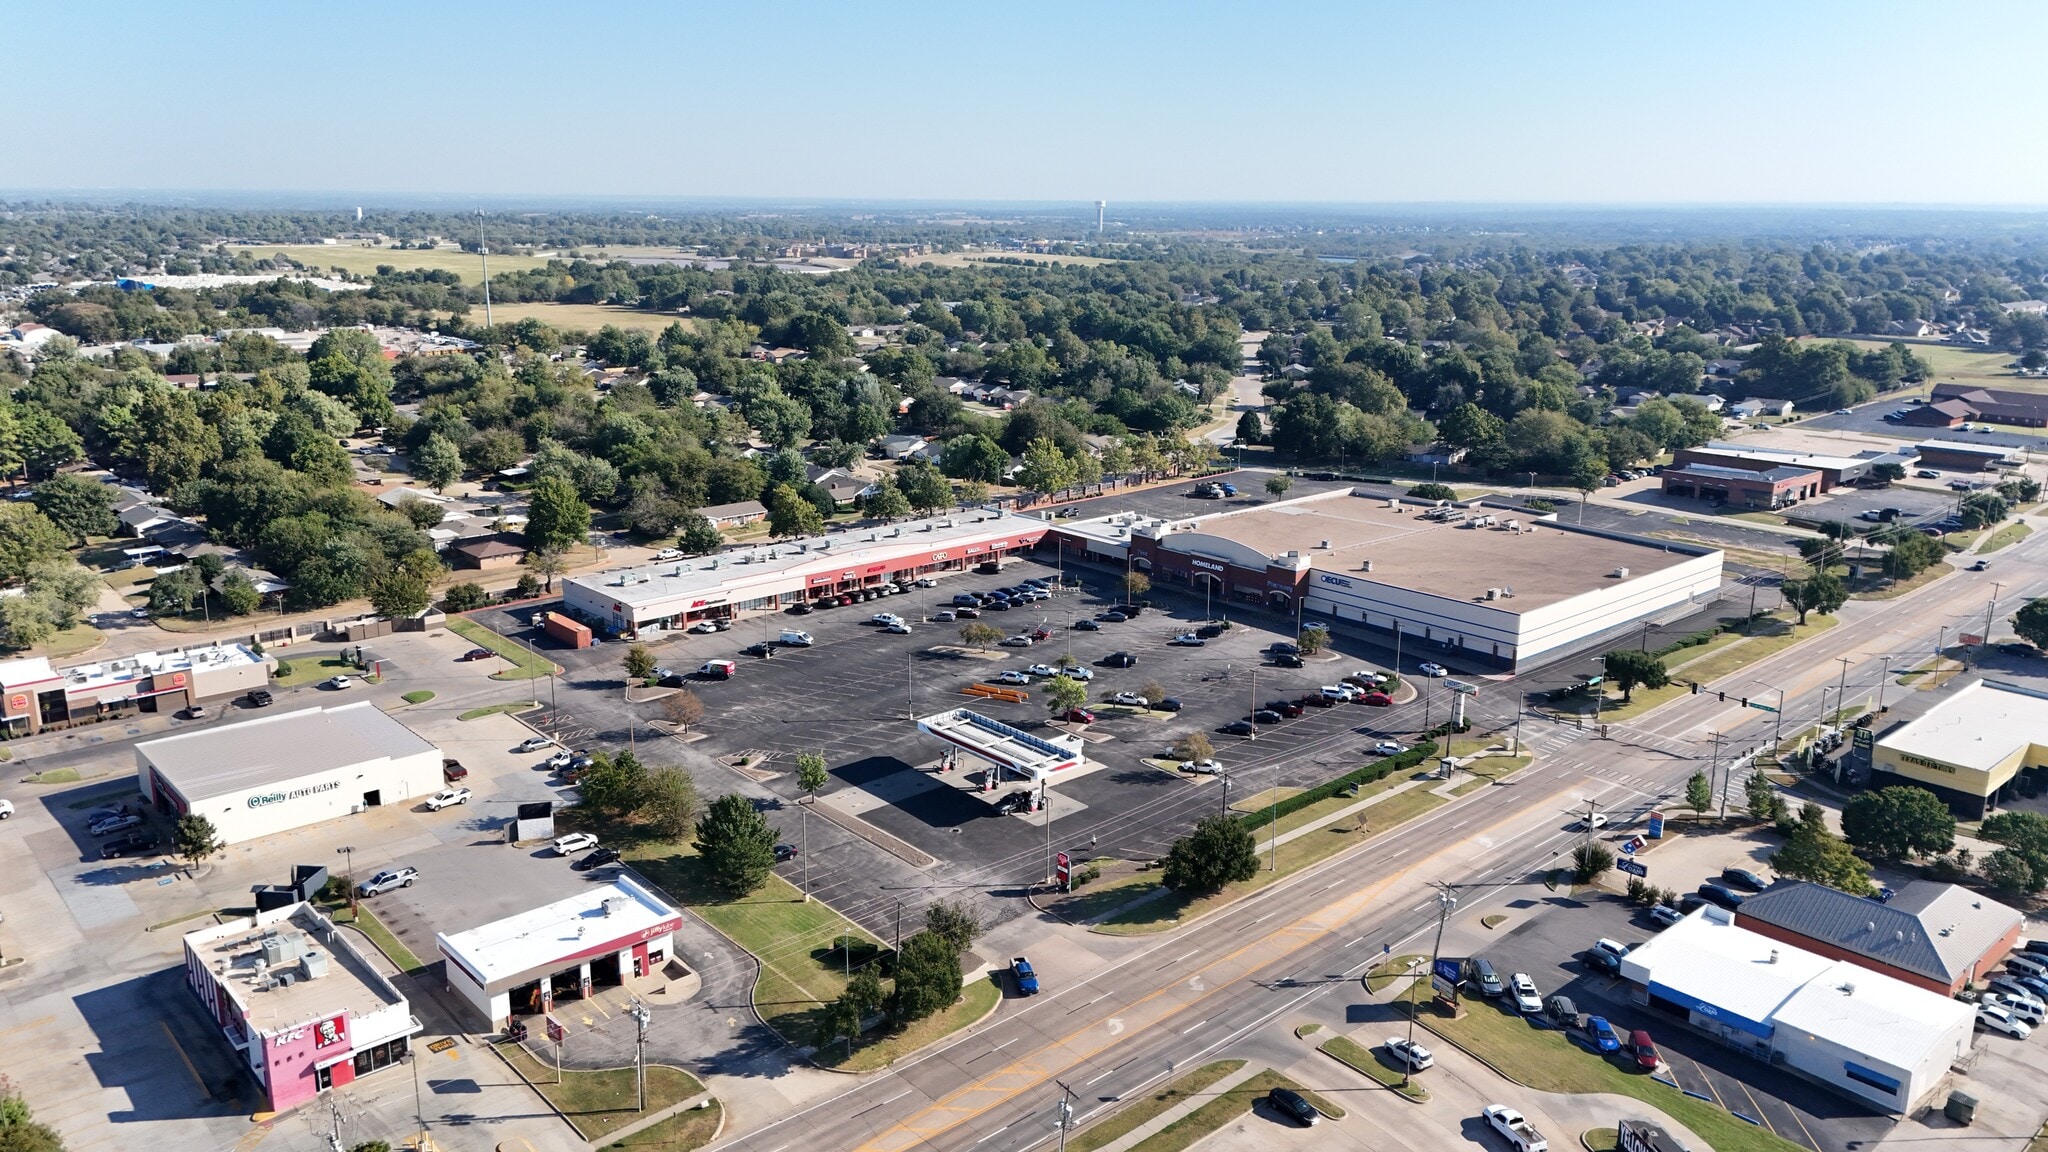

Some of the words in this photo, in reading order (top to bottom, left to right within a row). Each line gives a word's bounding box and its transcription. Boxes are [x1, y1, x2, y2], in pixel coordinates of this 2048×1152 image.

[1191, 559, 1224, 572] HOMELAND
[691, 600, 705, 608] ACE
[288, 788, 312, 800] AUTO
[313, 781, 341, 794] PARTS
[275, 1030, 304, 1047] KFC
